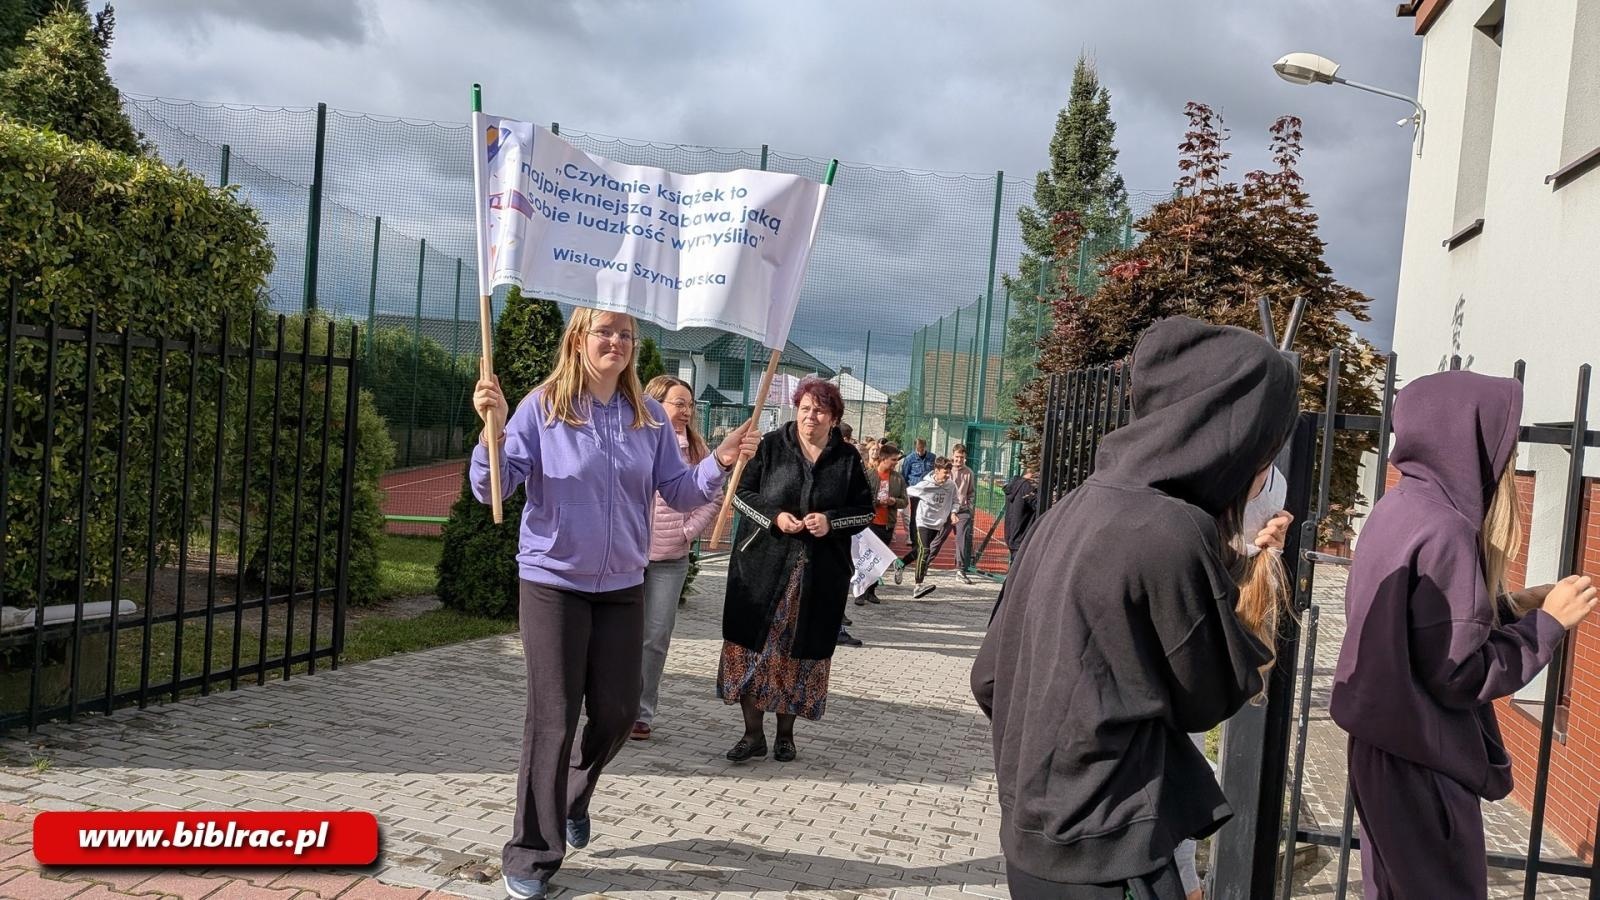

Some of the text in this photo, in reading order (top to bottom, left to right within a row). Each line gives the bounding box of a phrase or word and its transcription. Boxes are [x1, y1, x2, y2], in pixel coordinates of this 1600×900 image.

[521, 161, 653, 217] najpiękniejsza
[741, 205, 781, 235] jaką
[657, 184, 725, 208] książek
[731, 186, 748, 200] to
[528, 192, 571, 223] sobie
[577, 211, 666, 243] ludzkość
[553, 248, 628, 272] Wisława
